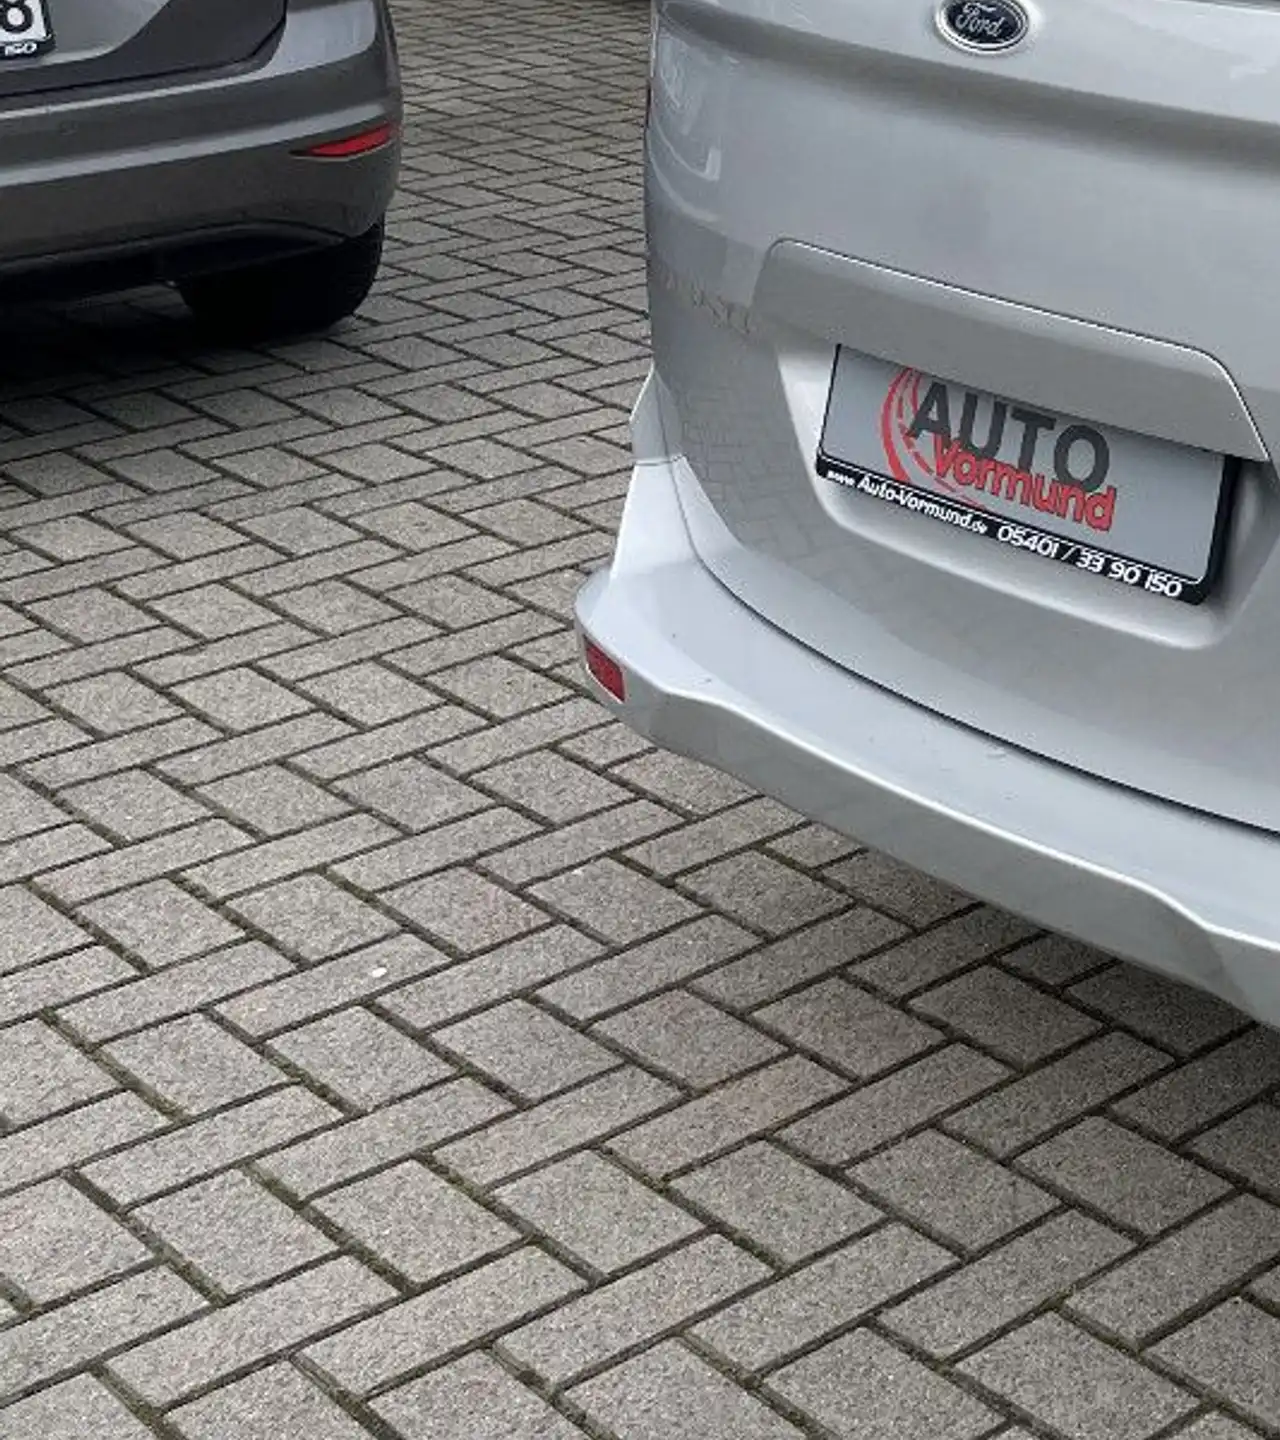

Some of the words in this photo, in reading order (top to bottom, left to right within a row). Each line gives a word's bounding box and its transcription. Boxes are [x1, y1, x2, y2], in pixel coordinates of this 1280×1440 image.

[956, 2, 1005, 37] Ford
[909, 382, 1110, 492] AUTO
[932, 432, 1117, 532] Vormund
[997, 525, 1060, 558] 05401
[1076, 548, 1105, 573] 33
[1108, 560, 1141, 584] 90
[1144, 573, 1182, 597] 150
